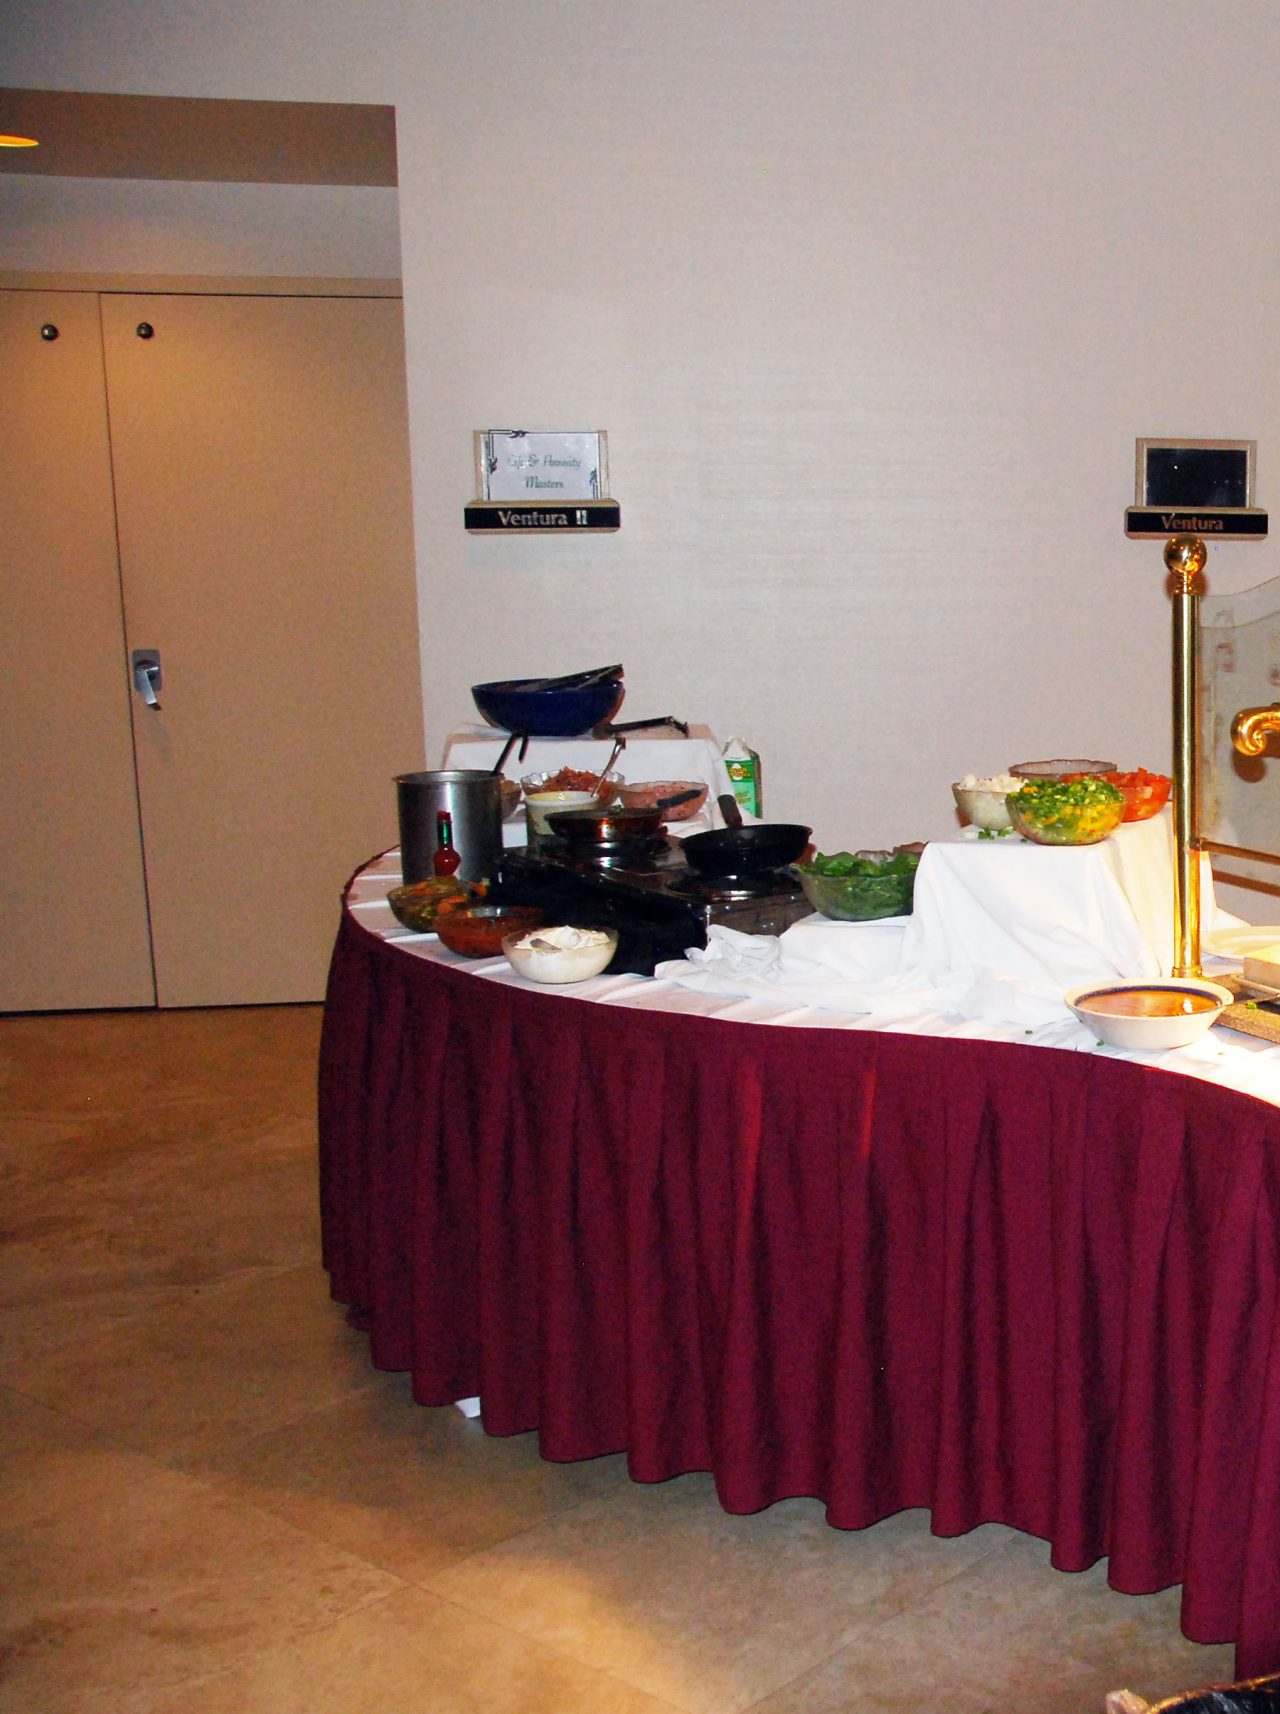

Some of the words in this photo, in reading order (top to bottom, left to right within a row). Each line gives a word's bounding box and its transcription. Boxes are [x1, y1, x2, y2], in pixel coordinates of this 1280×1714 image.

[525, 476, 564, 489] Masters
[498, 510, 568, 526] Ventura
[576, 510, 588, 525] II
[1161, 514, 1224, 530] Ventura
